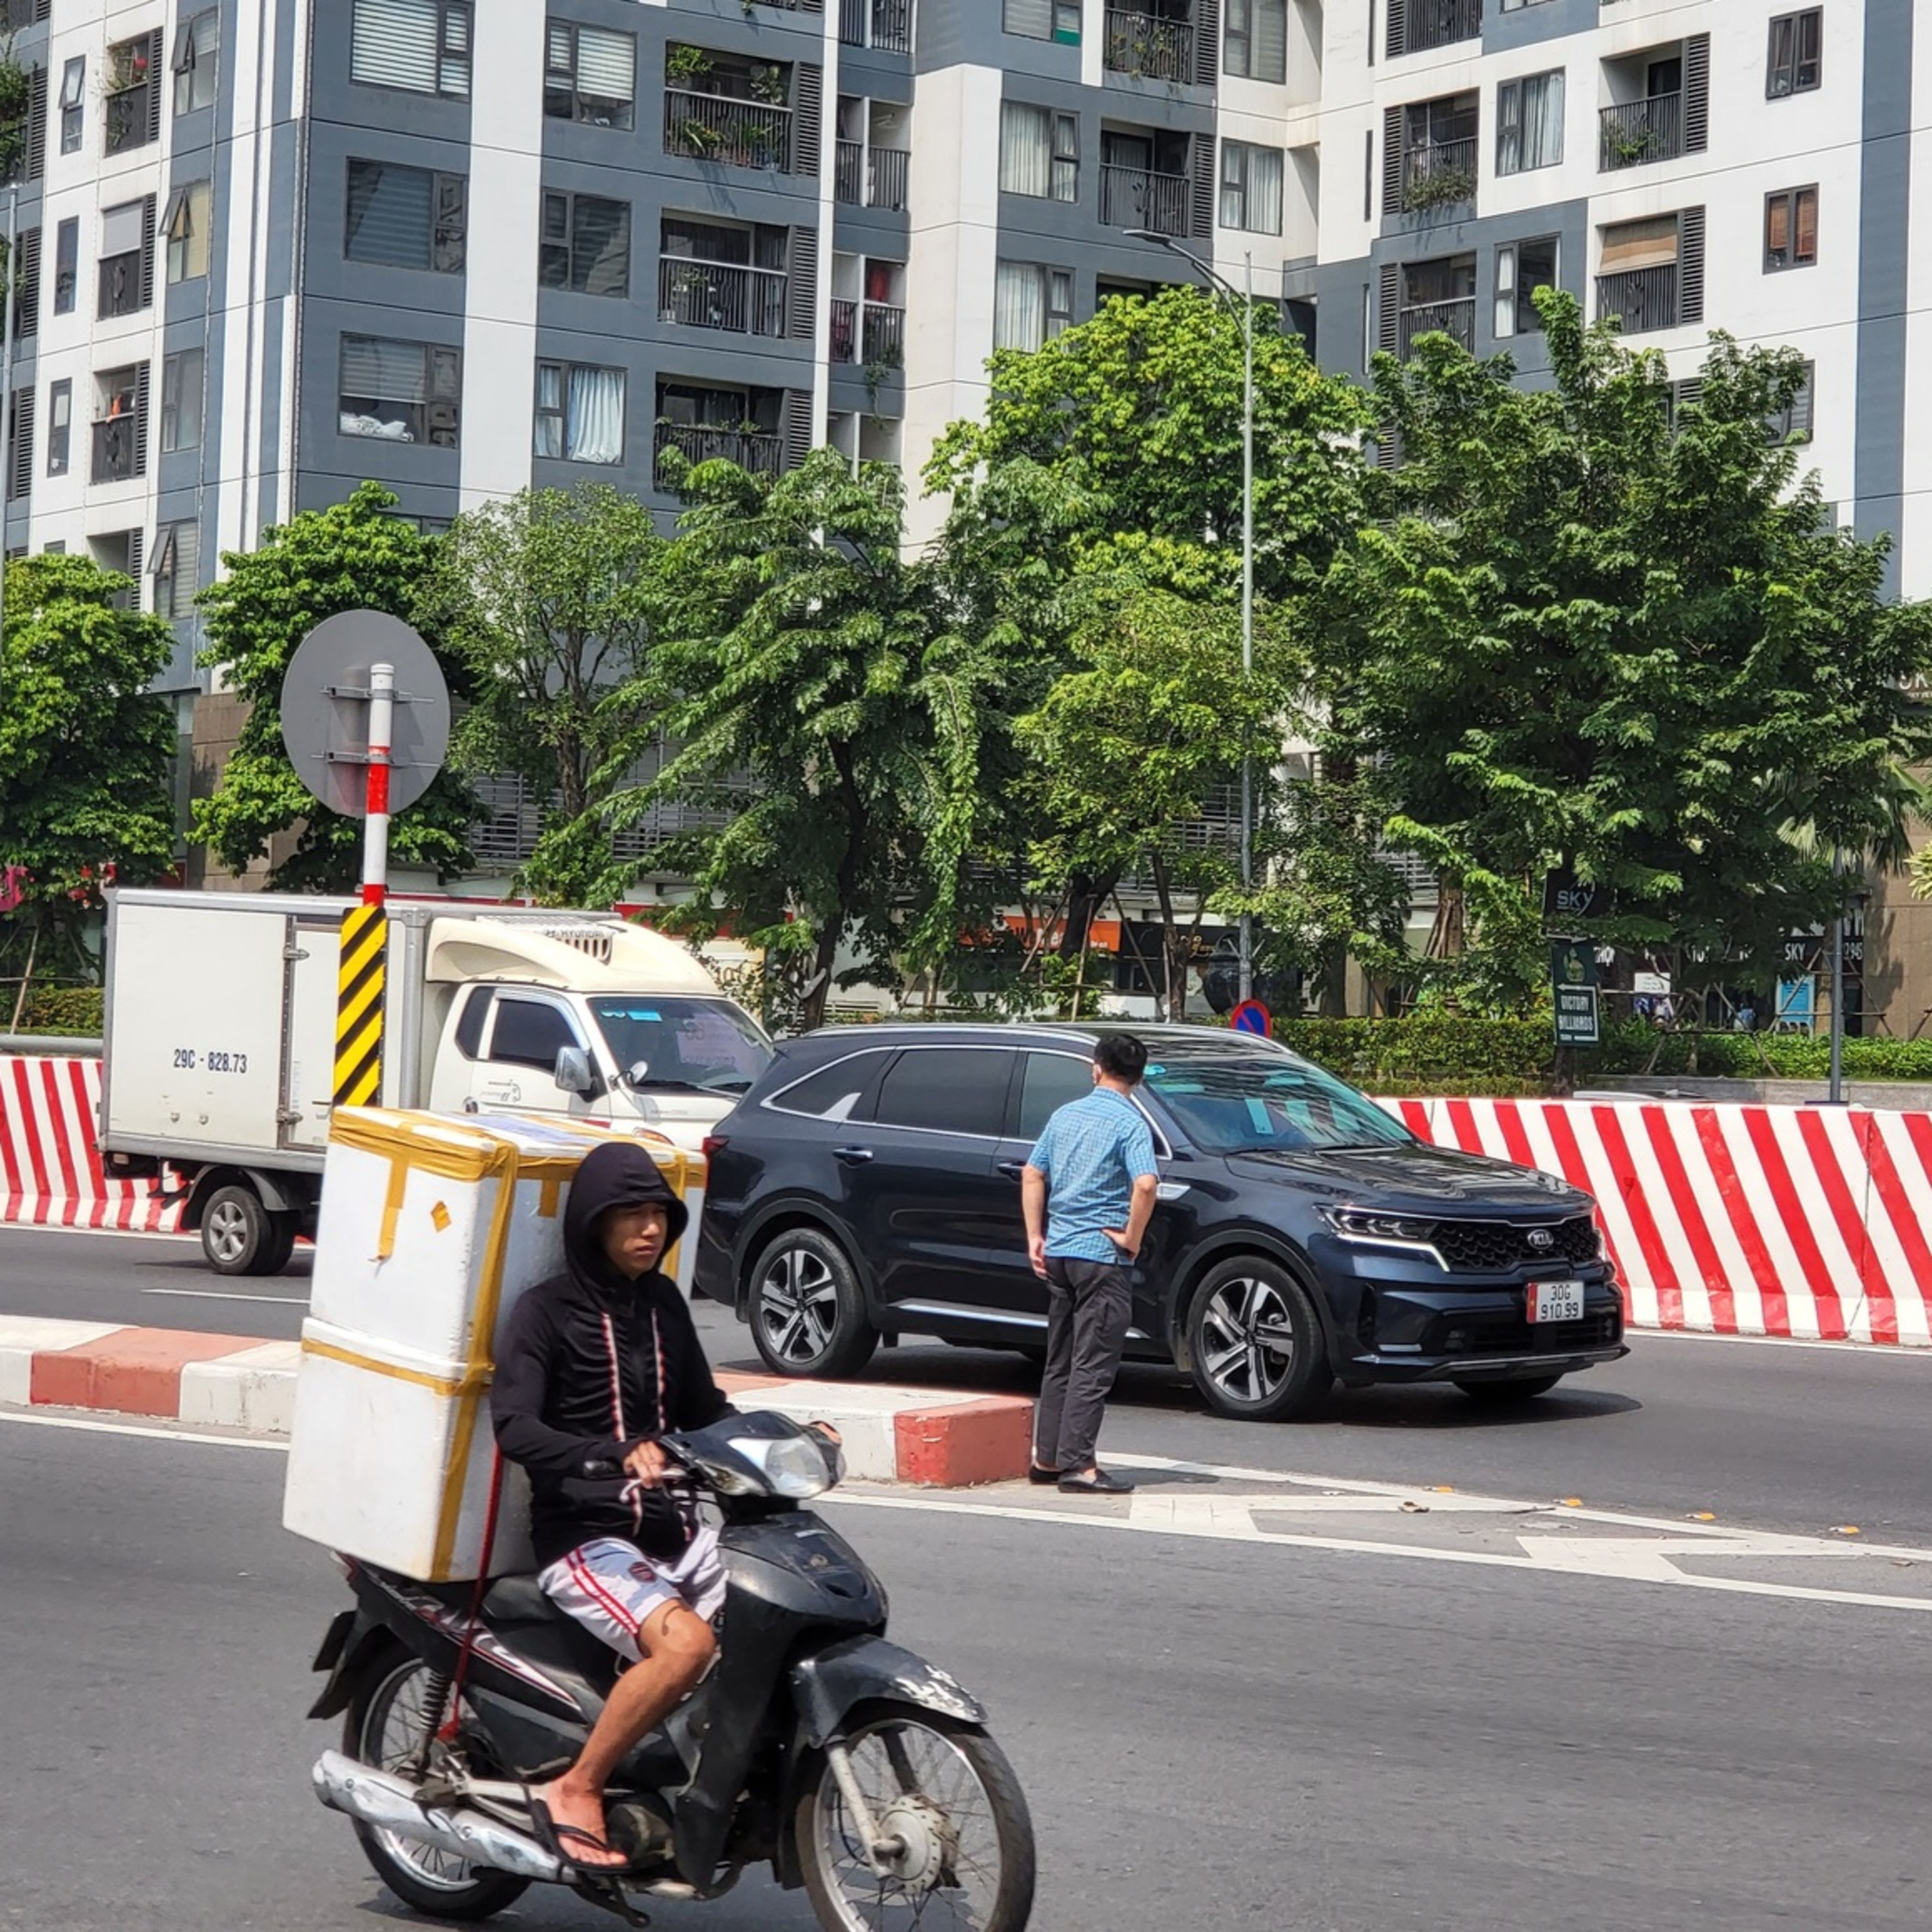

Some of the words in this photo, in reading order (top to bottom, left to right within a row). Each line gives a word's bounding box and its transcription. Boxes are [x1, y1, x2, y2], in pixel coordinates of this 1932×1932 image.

[1557, 890, 1594, 916] SKY
[1785, 942, 1806, 960] SKY
[173, 1048, 196, 1069] 29C
[208, 1051, 247, 1074] 828.73
[1533, 1233, 1552, 1245] KIA
[1551, 1284, 1571, 1301] 30G
[1541, 1302, 1578, 1320] 910.99
